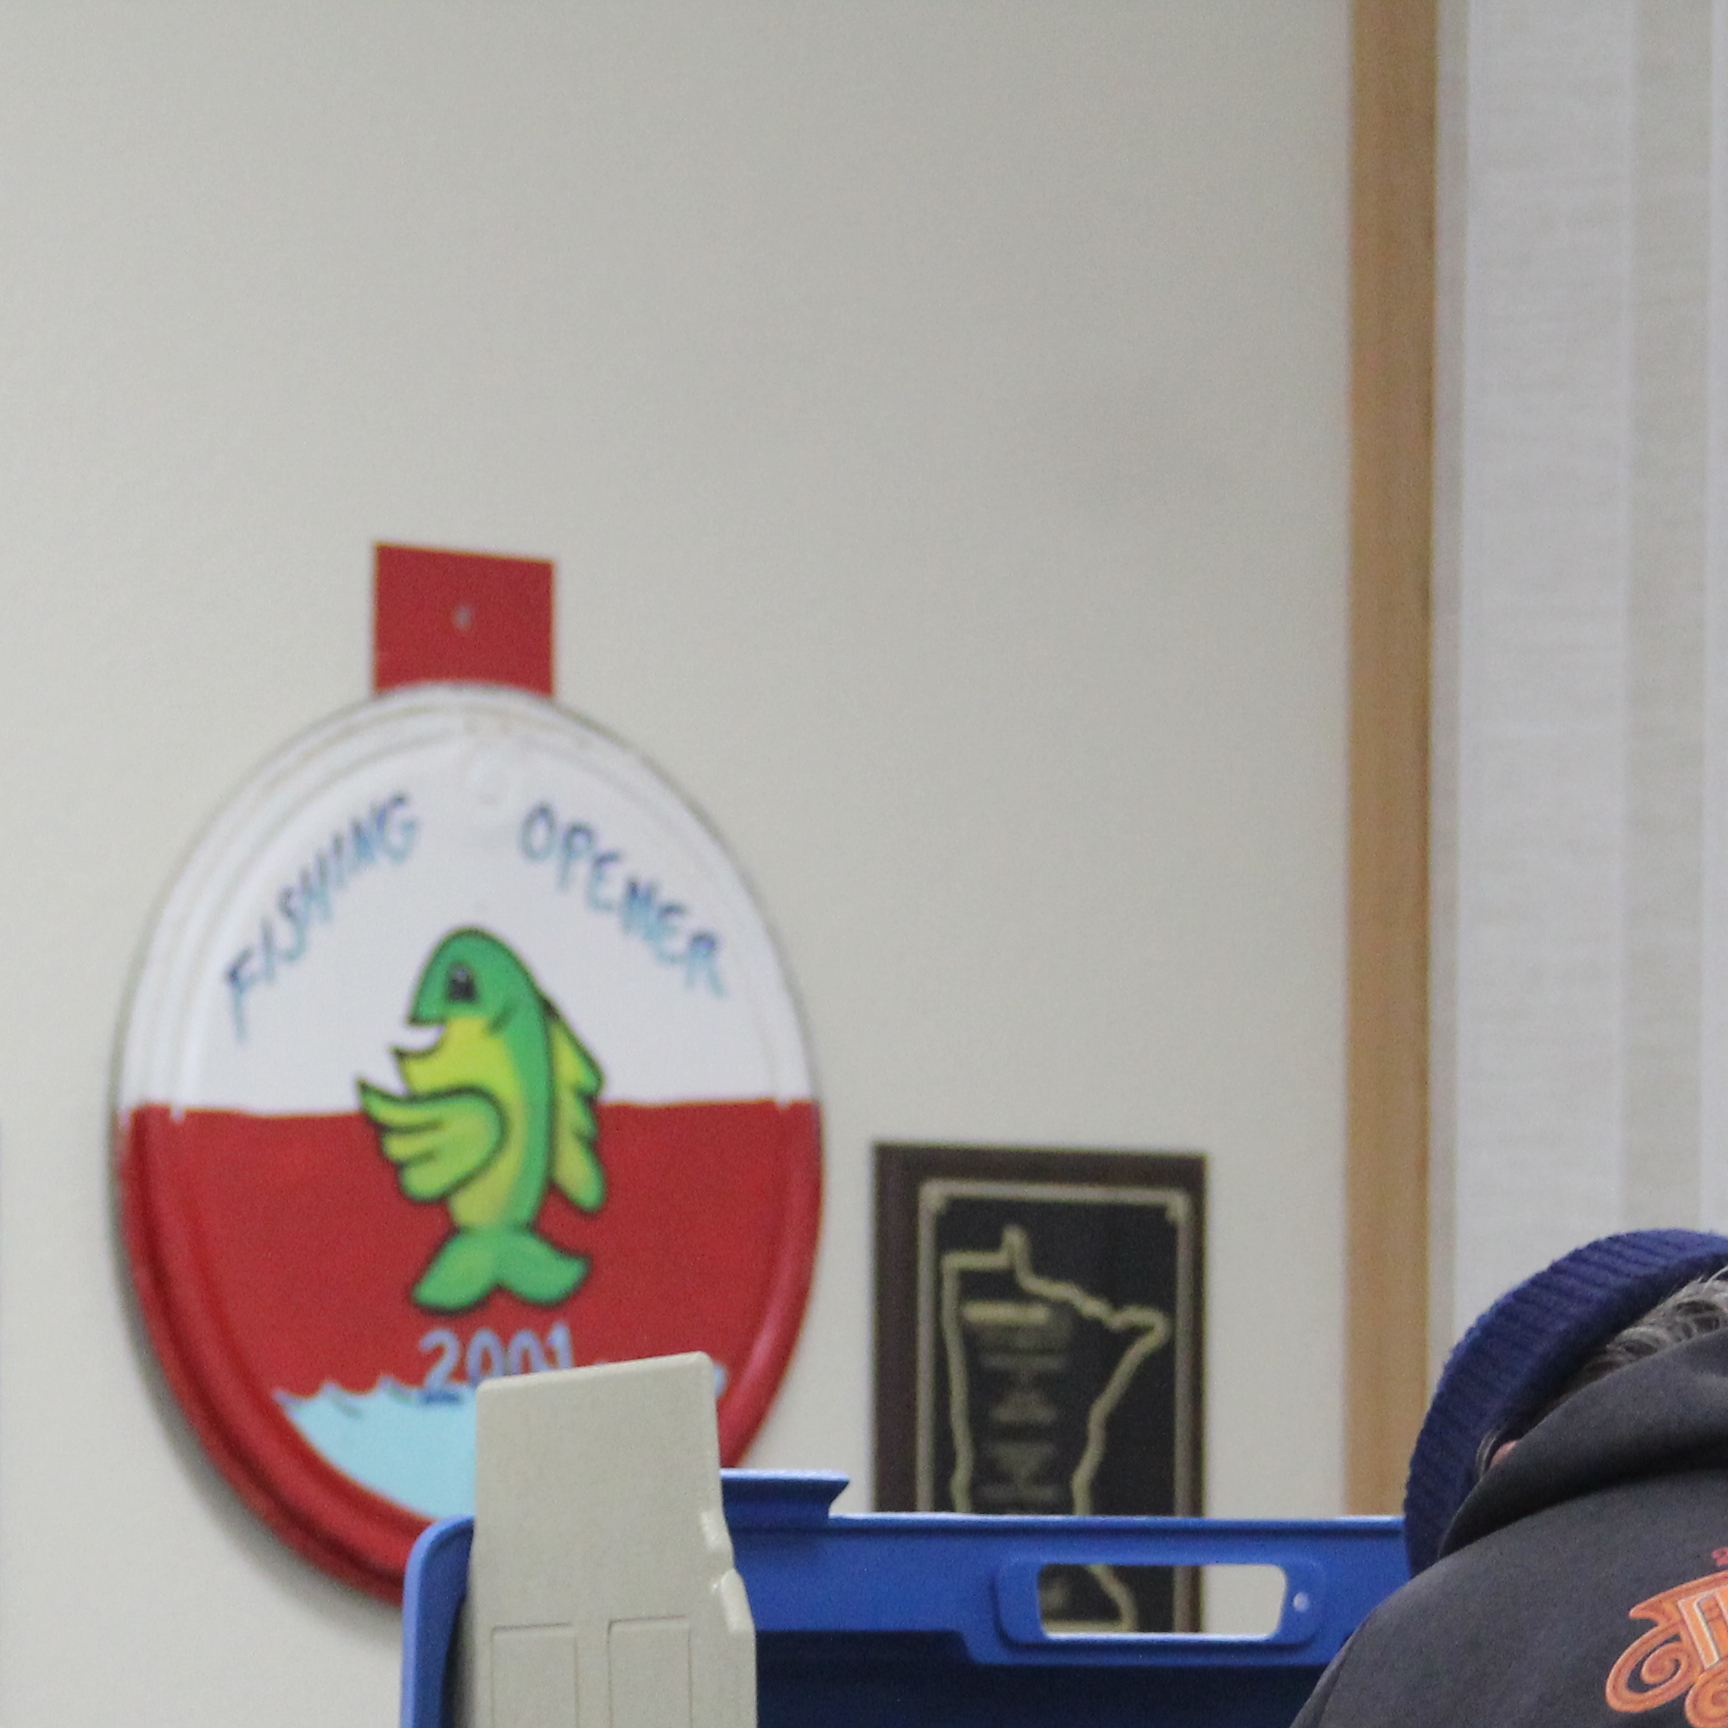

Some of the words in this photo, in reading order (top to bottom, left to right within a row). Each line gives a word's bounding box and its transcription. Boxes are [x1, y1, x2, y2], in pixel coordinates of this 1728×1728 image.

[224, 790, 420, 1043] FISHING
[518, 800, 727, 1000] OPENER
[418, 1323, 573, 1392] 2001
